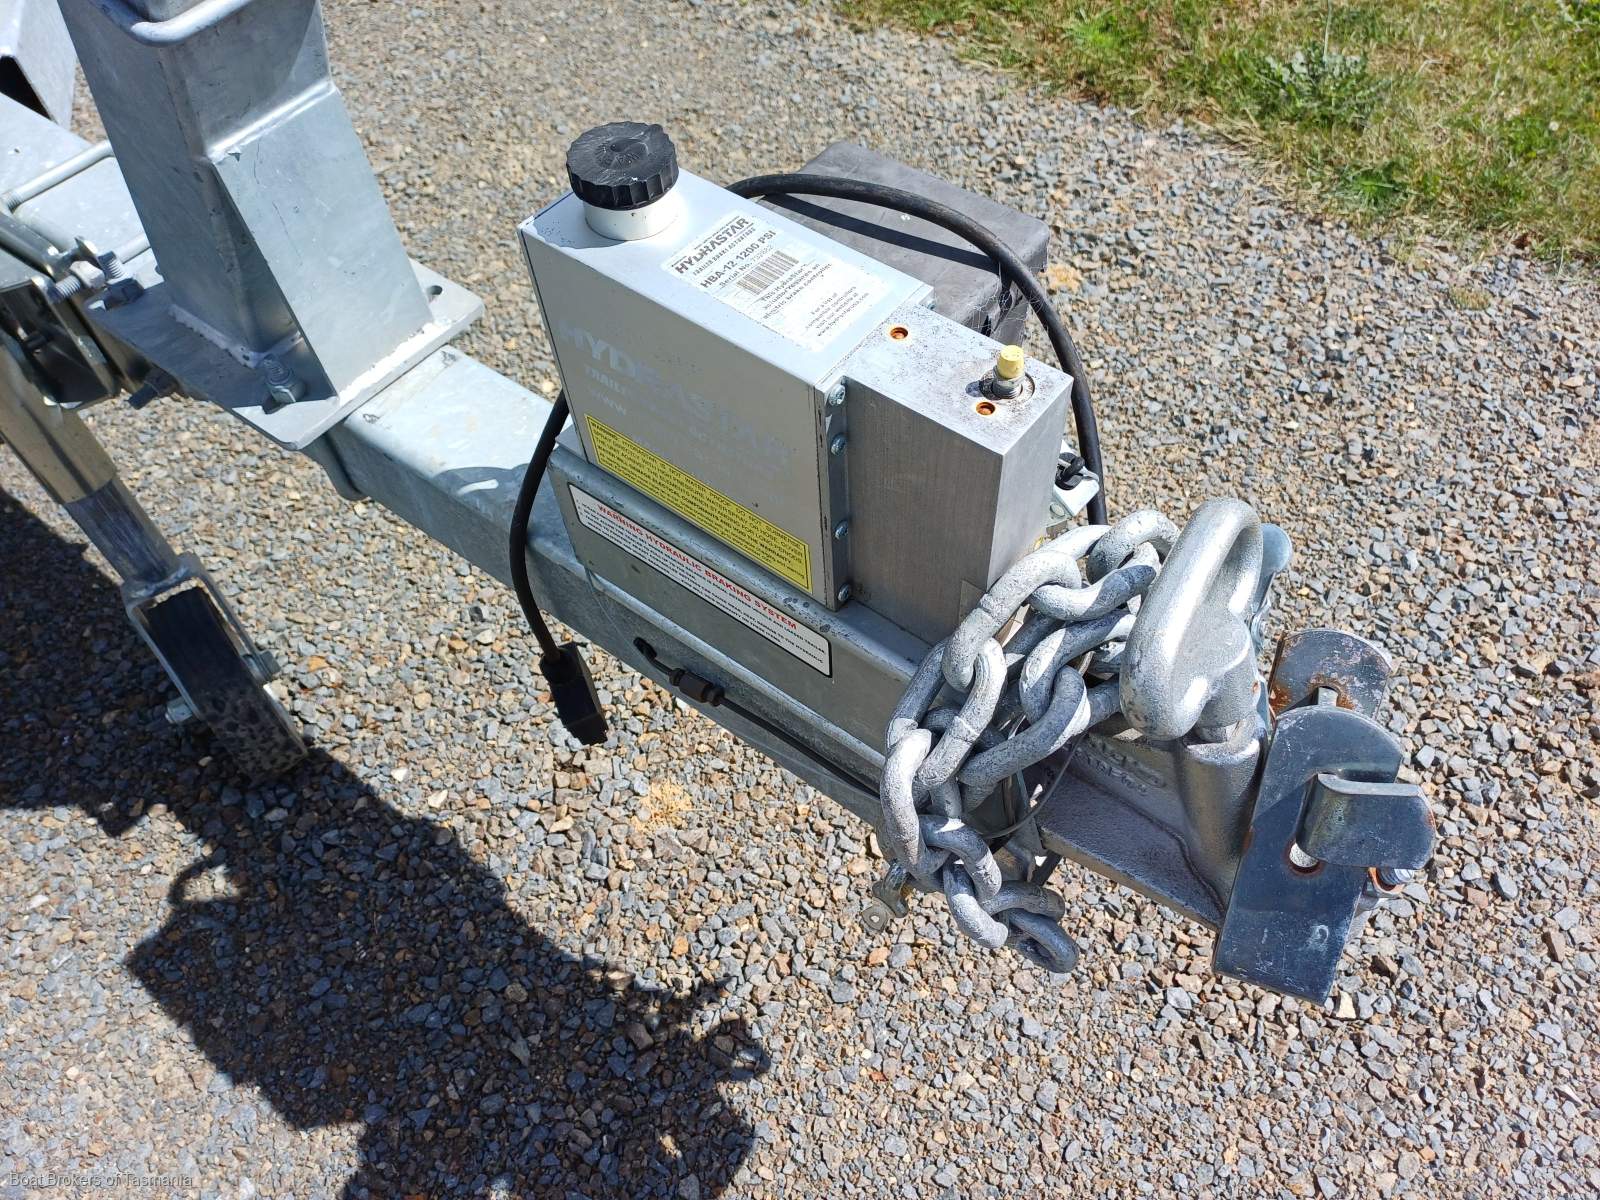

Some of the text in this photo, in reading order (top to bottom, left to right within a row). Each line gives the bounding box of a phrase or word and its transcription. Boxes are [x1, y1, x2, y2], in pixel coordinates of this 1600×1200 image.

[675, 218, 749, 274] HYDRASTAR
[700, 260, 738, 288] HBA-12
[736, 242, 760, 260] 1200
[758, 230, 776, 244] PSI
[719, 271, 740, 288] Serial
[596, 503, 643, 536] WARNING
[645, 532, 701, 572] HYDRAULIC
[704, 568, 750, 602] BRAKING
[754, 599, 796, 630] SYSTEM
